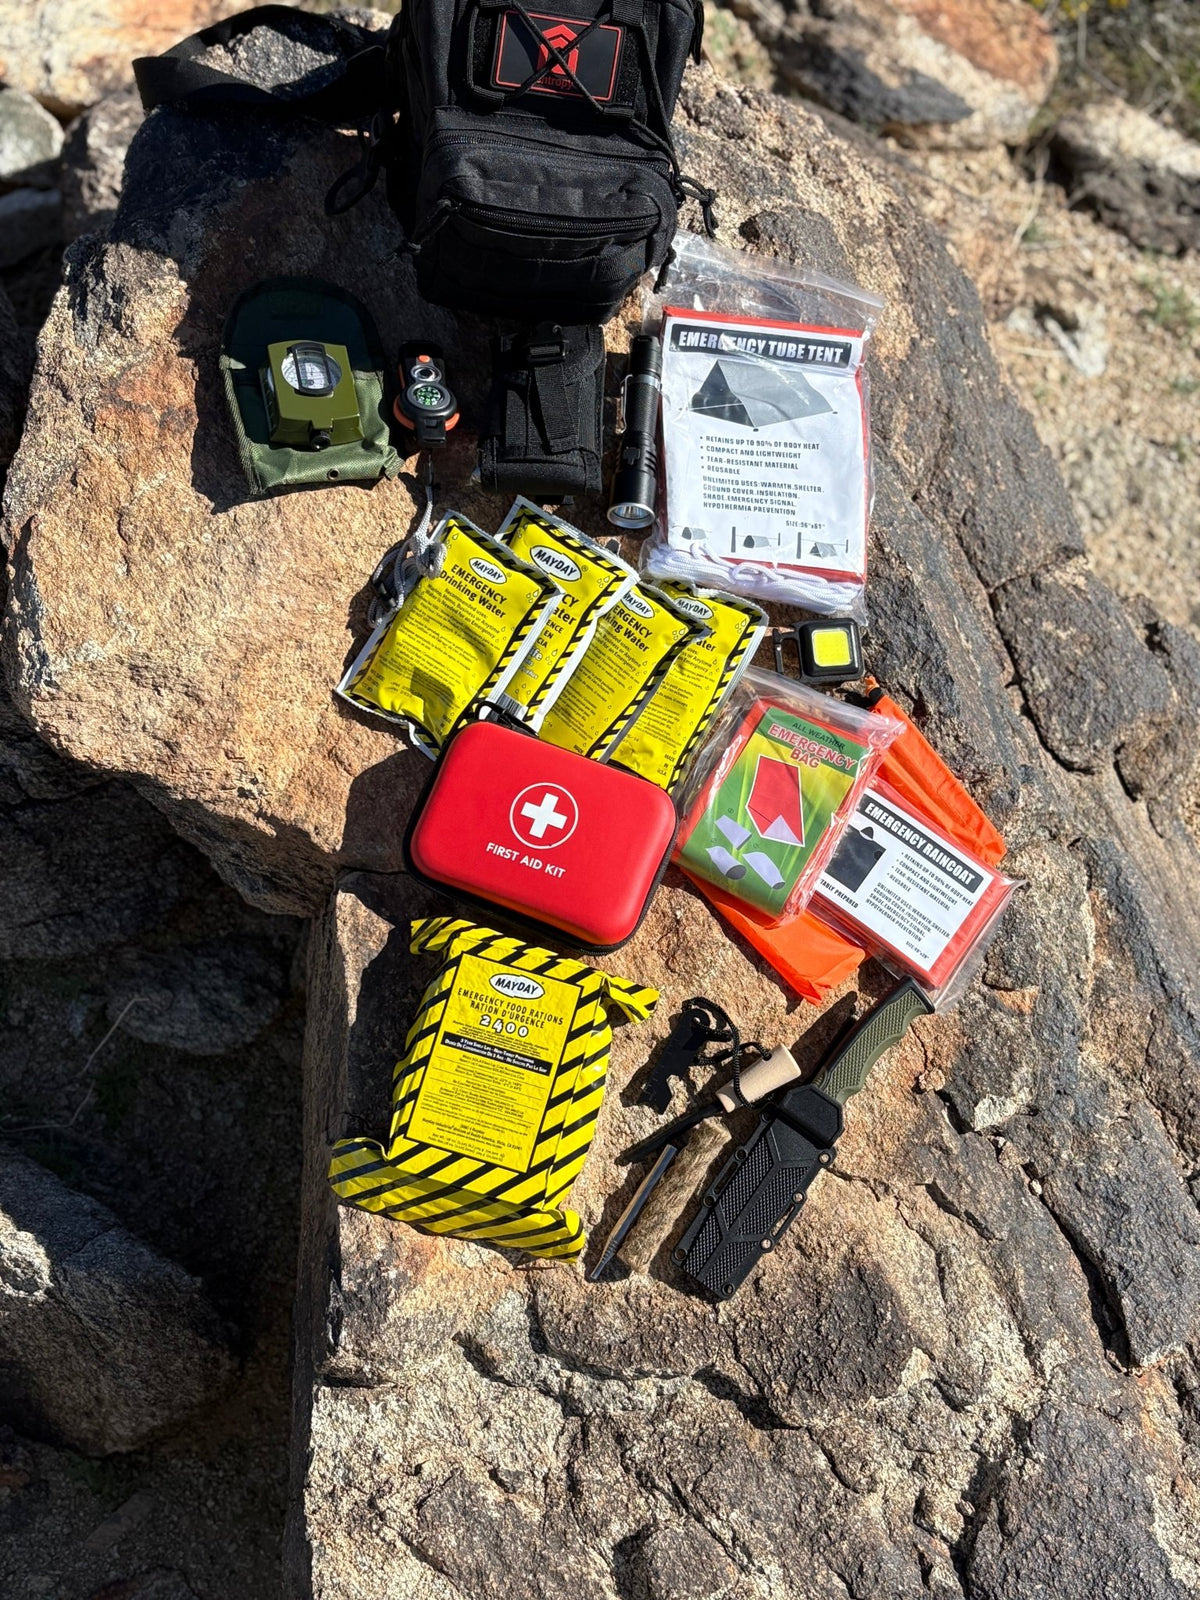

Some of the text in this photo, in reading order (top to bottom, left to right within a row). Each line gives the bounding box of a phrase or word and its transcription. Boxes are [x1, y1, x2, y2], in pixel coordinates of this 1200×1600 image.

[768, 341, 804, 360] TUBE
[807, 345, 844, 364] TENT
[706, 436, 734, 444] RETAINS
[756, 440, 772, 448] 90%
[706, 446, 738, 455] COMPACT
[756, 449, 801, 460] LIGHTWEIGHT
[707, 465, 740, 475] REUSABLE
[765, 461, 799, 470] MATERIAL
[702, 476, 740, 486] UNLIMITED
[703, 484, 730, 493] GROUND
[703, 501, 796, 516] HYPOTHERMIA PREVENTION
[473, 560, 503, 580] MAYDAY
[535, 550, 577, 577] MAYDAY
[440, 570, 506, 618] Drinking Water
[451, 564, 507, 605] EMERGENCY
[553, 607, 576, 625] ater
[677, 600, 710, 617] MAYDAY
[613, 606, 653, 639] ERGENCY
[624, 628, 650, 652] Water
[696, 640, 716, 652] ater
[792, 722, 806, 733] ALL
[769, 724, 857, 770] EMERGENCY
[790, 748, 820, 769] BAG
[865, 803, 975, 885] EMERGENCY RAINCOAT
[486, 842, 566, 878] FIRST AID KIT
[904, 854, 923, 869] RETAINS
[899, 861, 957, 905] COMPACT AND LIGHTWEIGHT
[834, 890, 858, 908] PREPARED
[929, 893, 951, 910] MATERIAL
[495, 978, 538, 995] MAYDAY
[457, 988, 564, 1026] EMERGENCY FOOD RATIONS
[470, 1001, 545, 1029] RATION D'URGENCE
[480, 1014, 529, 1037] 2400
